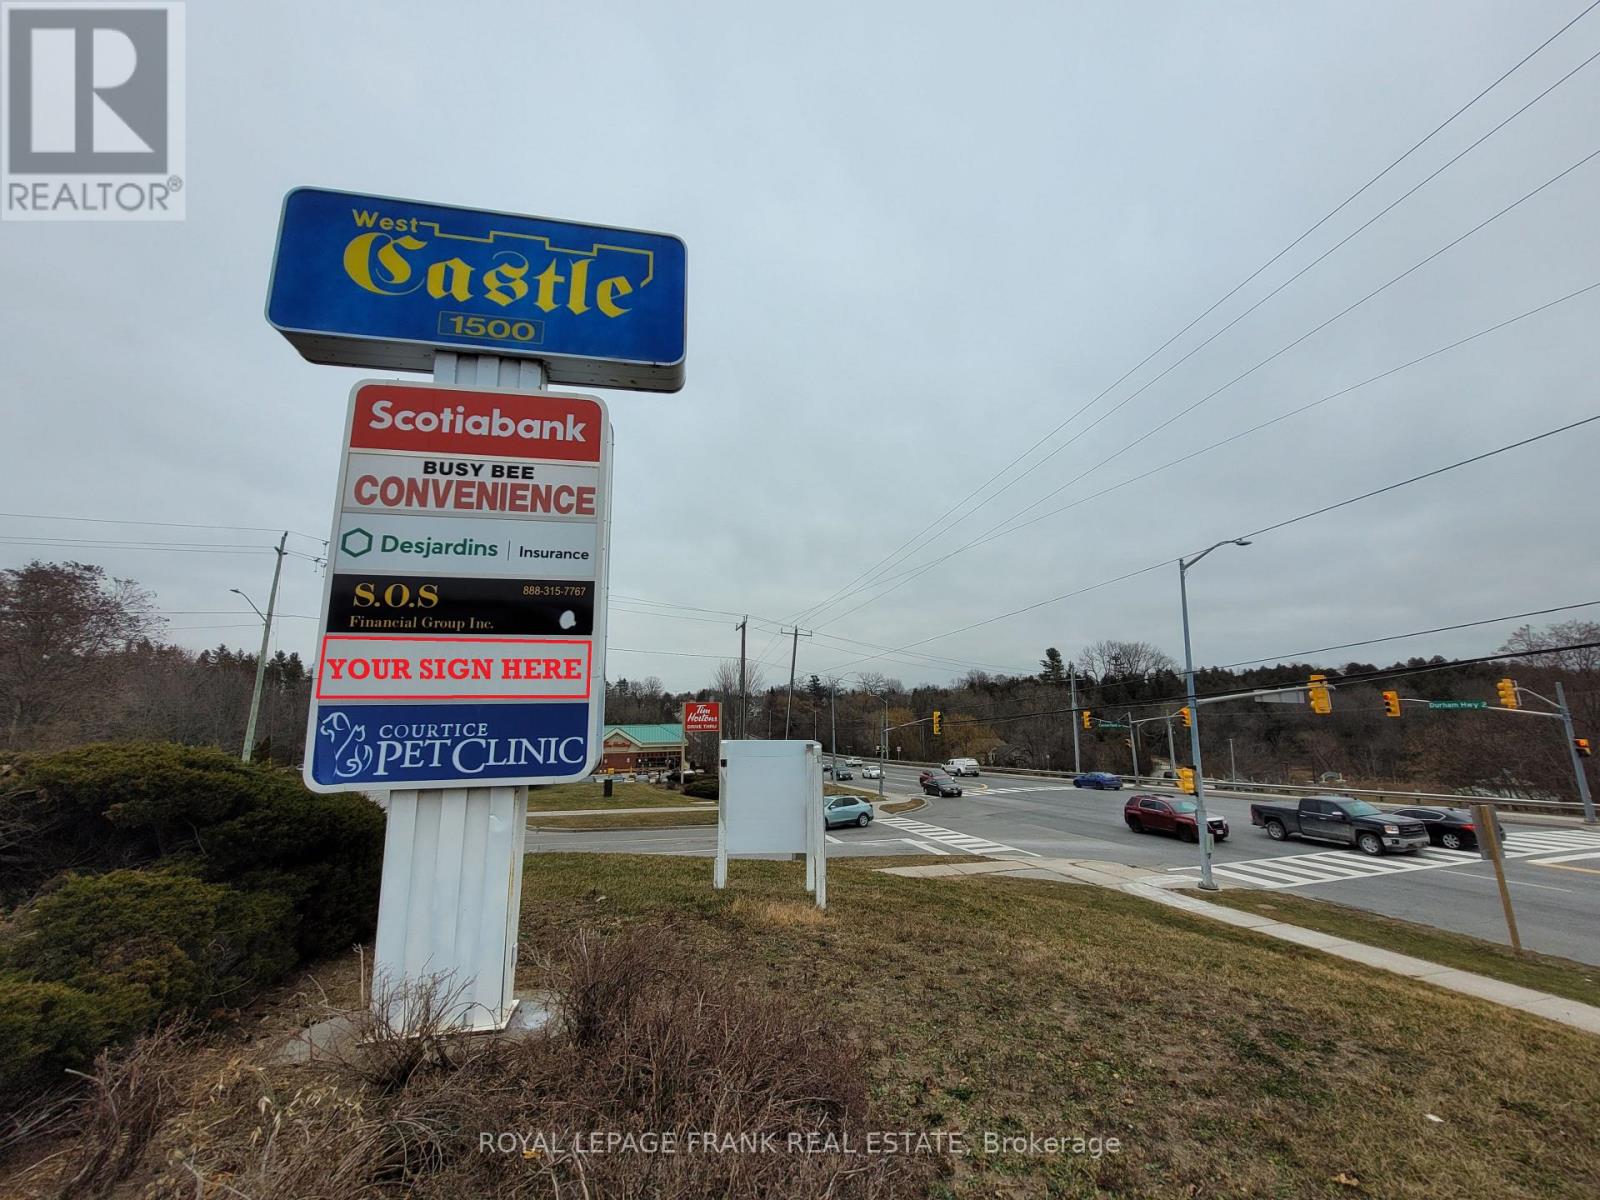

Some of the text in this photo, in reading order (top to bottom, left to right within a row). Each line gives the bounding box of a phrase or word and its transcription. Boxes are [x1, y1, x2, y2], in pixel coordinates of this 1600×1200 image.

[352, 208, 419, 233] West
[343, 231, 633, 318] Castle
[450, 315, 535, 342] 1500
[369, 400, 586, 442] Scotiabank
[423, 461, 535, 480] BUSY BEE
[354, 474, 596, 516] CONVENIENCE
[381, 534, 589, 560] Desjardins Insurance
[353, 582, 586, 609] S.O.S 888-315-7767
[350, 615, 494, 631] Financial Group Inc.
[687, 712, 718, 722] Hortons
[696, 704, 711, 714] Tim
[1460, 701, 1480, 709] Hwy
[379, 723, 488, 738] COURTICE
